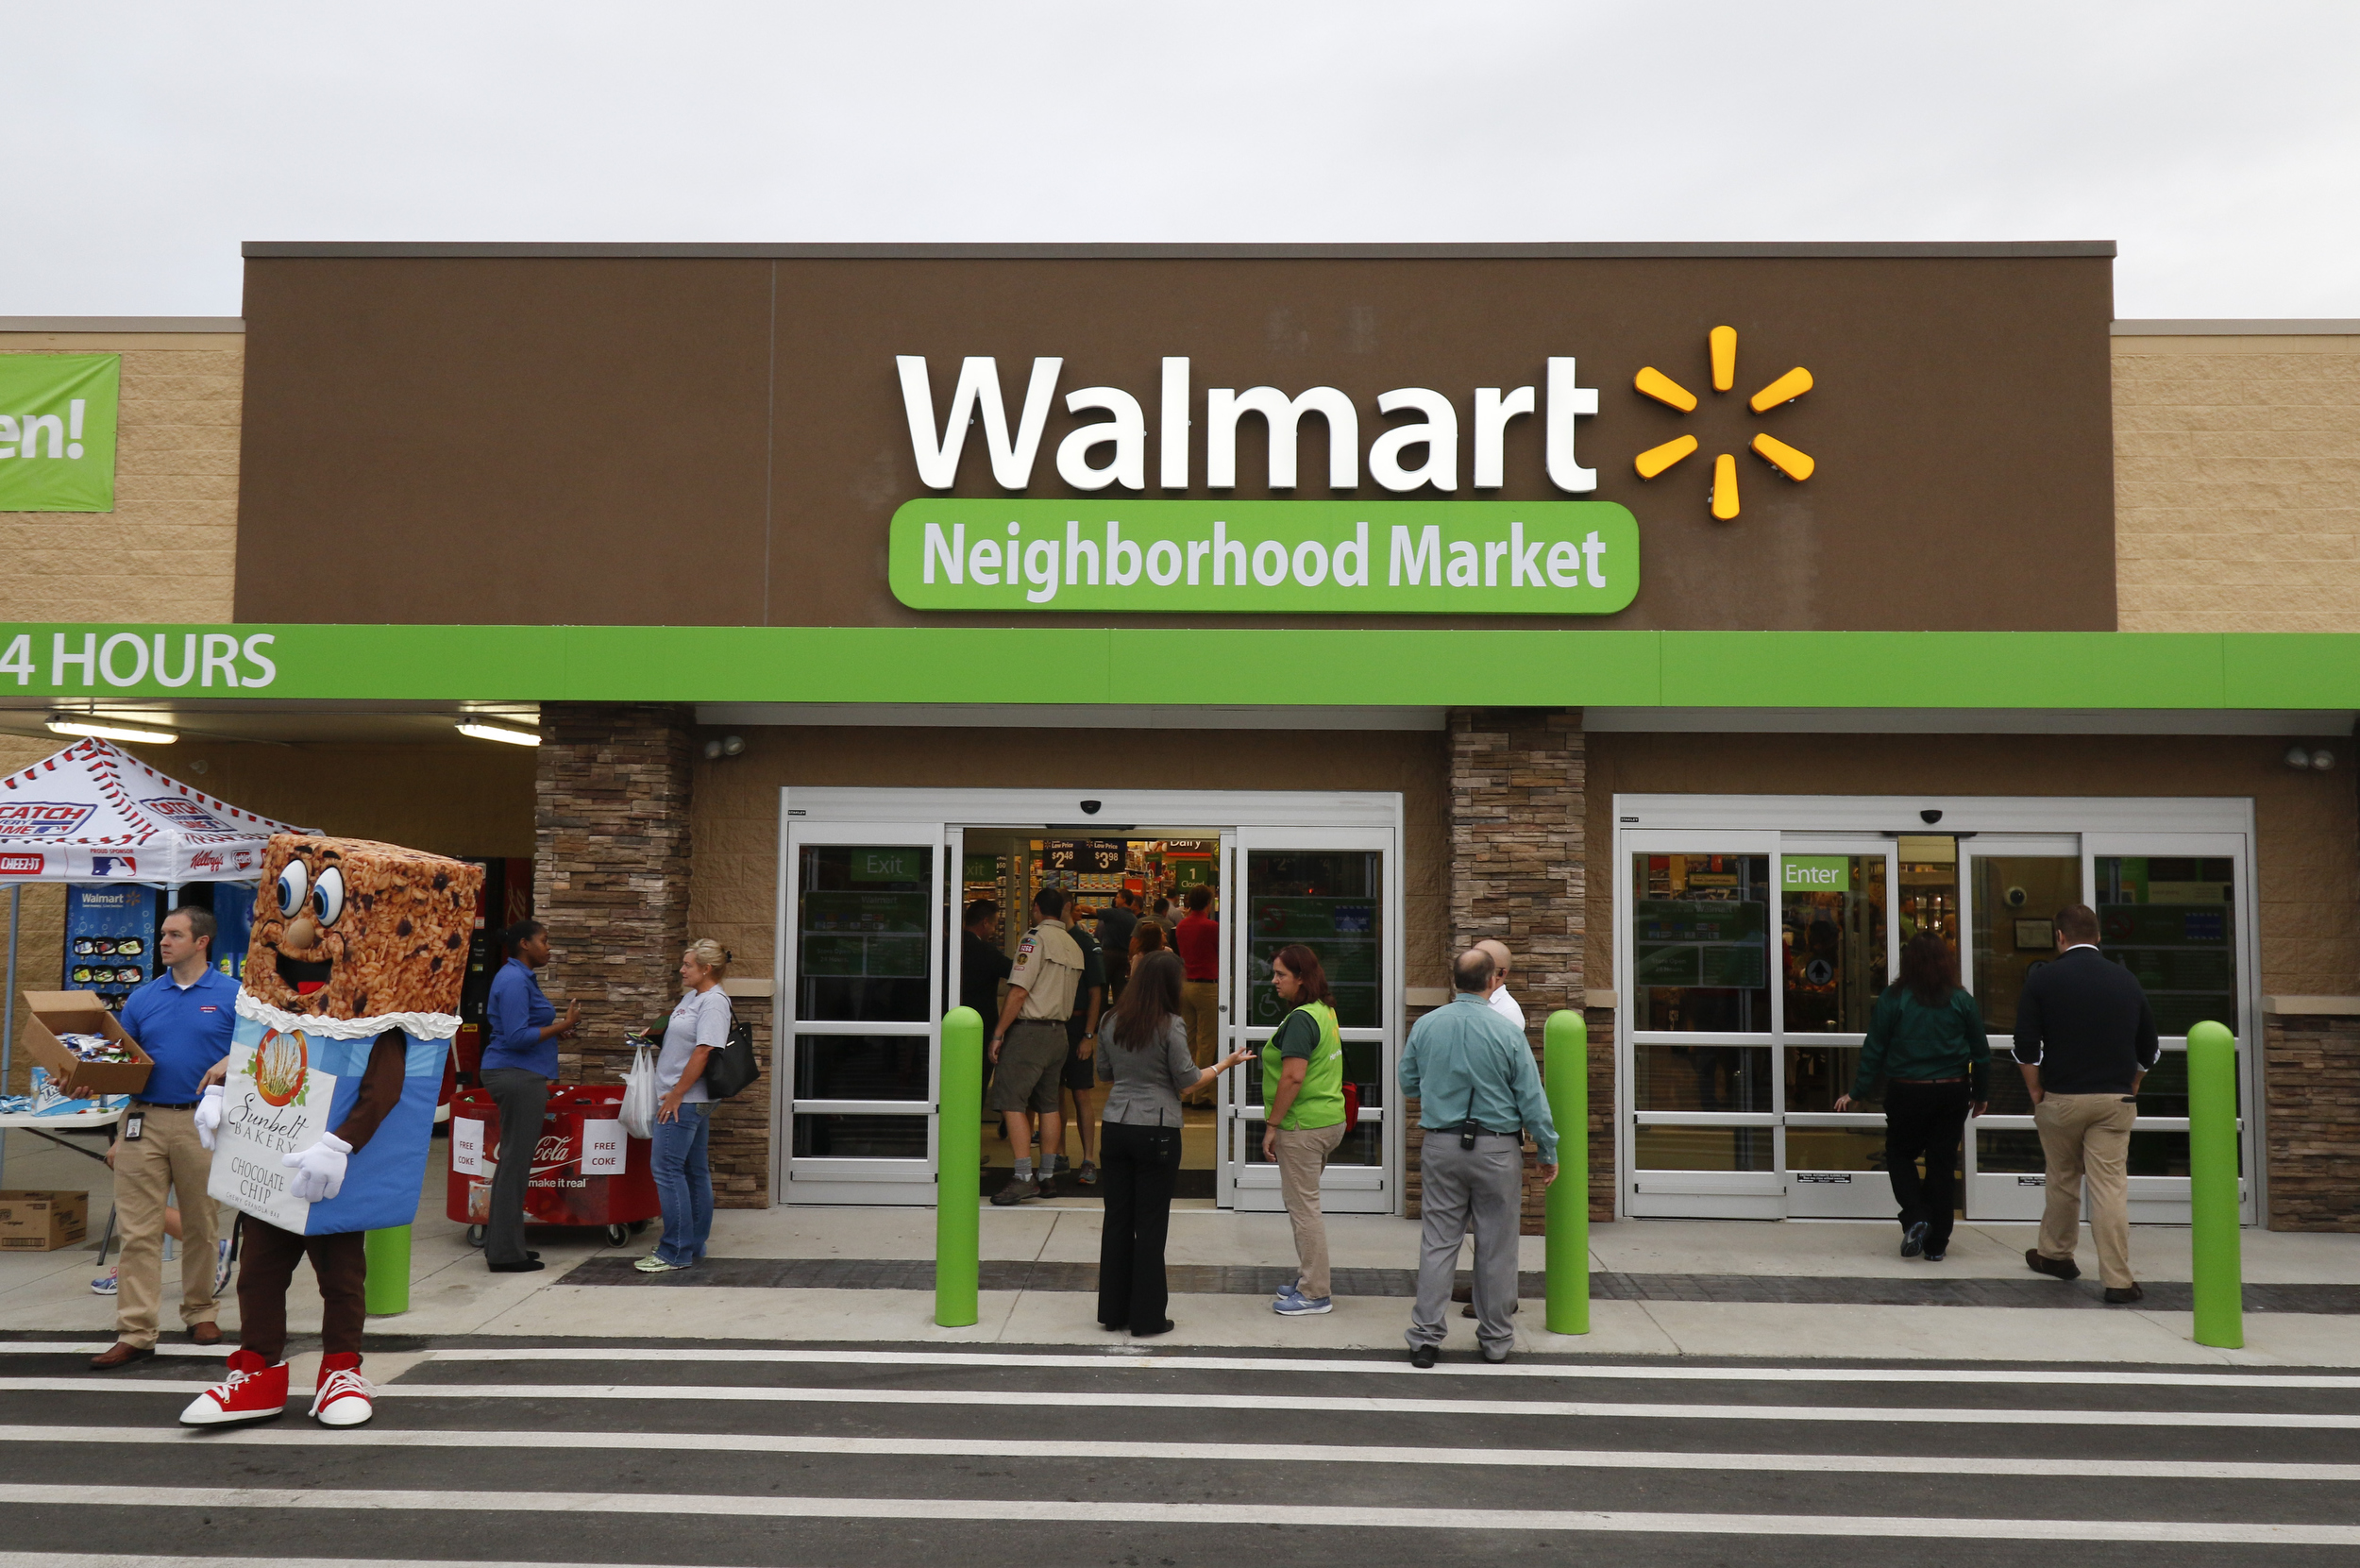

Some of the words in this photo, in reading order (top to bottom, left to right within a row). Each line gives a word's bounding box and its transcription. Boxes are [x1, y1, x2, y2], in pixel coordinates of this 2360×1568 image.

[0, 399, 86, 460] en!
[896, 355, 1599, 494] Walmart
[922, 521, 1369, 603] Neighborhood
[1389, 522, 1607, 589] Market
[0, 634, 35, 685] 4
[51, 632, 277, 688] HOURS
[0, 806, 87, 819] CATCH
[1, 857, 41, 870] CHEEZ-IT
[191, 851, 224, 871] Kellogg's
[867, 854, 903, 874] Exit
[965, 862, 985, 876] xit
[1189, 868, 1196, 880] 1
[1786, 865, 1839, 884] Enter
[82, 893, 125, 903] Walmart
[861, 896, 898, 904] Walmart
[228, 1093, 309, 1140] Sunbelt
[234, 1121, 297, 1154] BAKERY
[459, 1140, 474, 1151] FREE
[594, 1141, 615, 1150] FREE
[458, 1155, 475, 1166] COKE
[592, 1157, 616, 1166] COKE
[231, 1156, 284, 1192] CHOCOLATE
[529, 1178, 556, 1188] make
[557, 1178, 565, 1188] it
[566, 1178, 586, 1188] real
[240, 1180, 271, 1205] CHIP
[226, 1191, 243, 1205] CHEWY
[244, 1200, 269, 1214] GRANOLA
[270, 1210, 280, 1220] BAR
